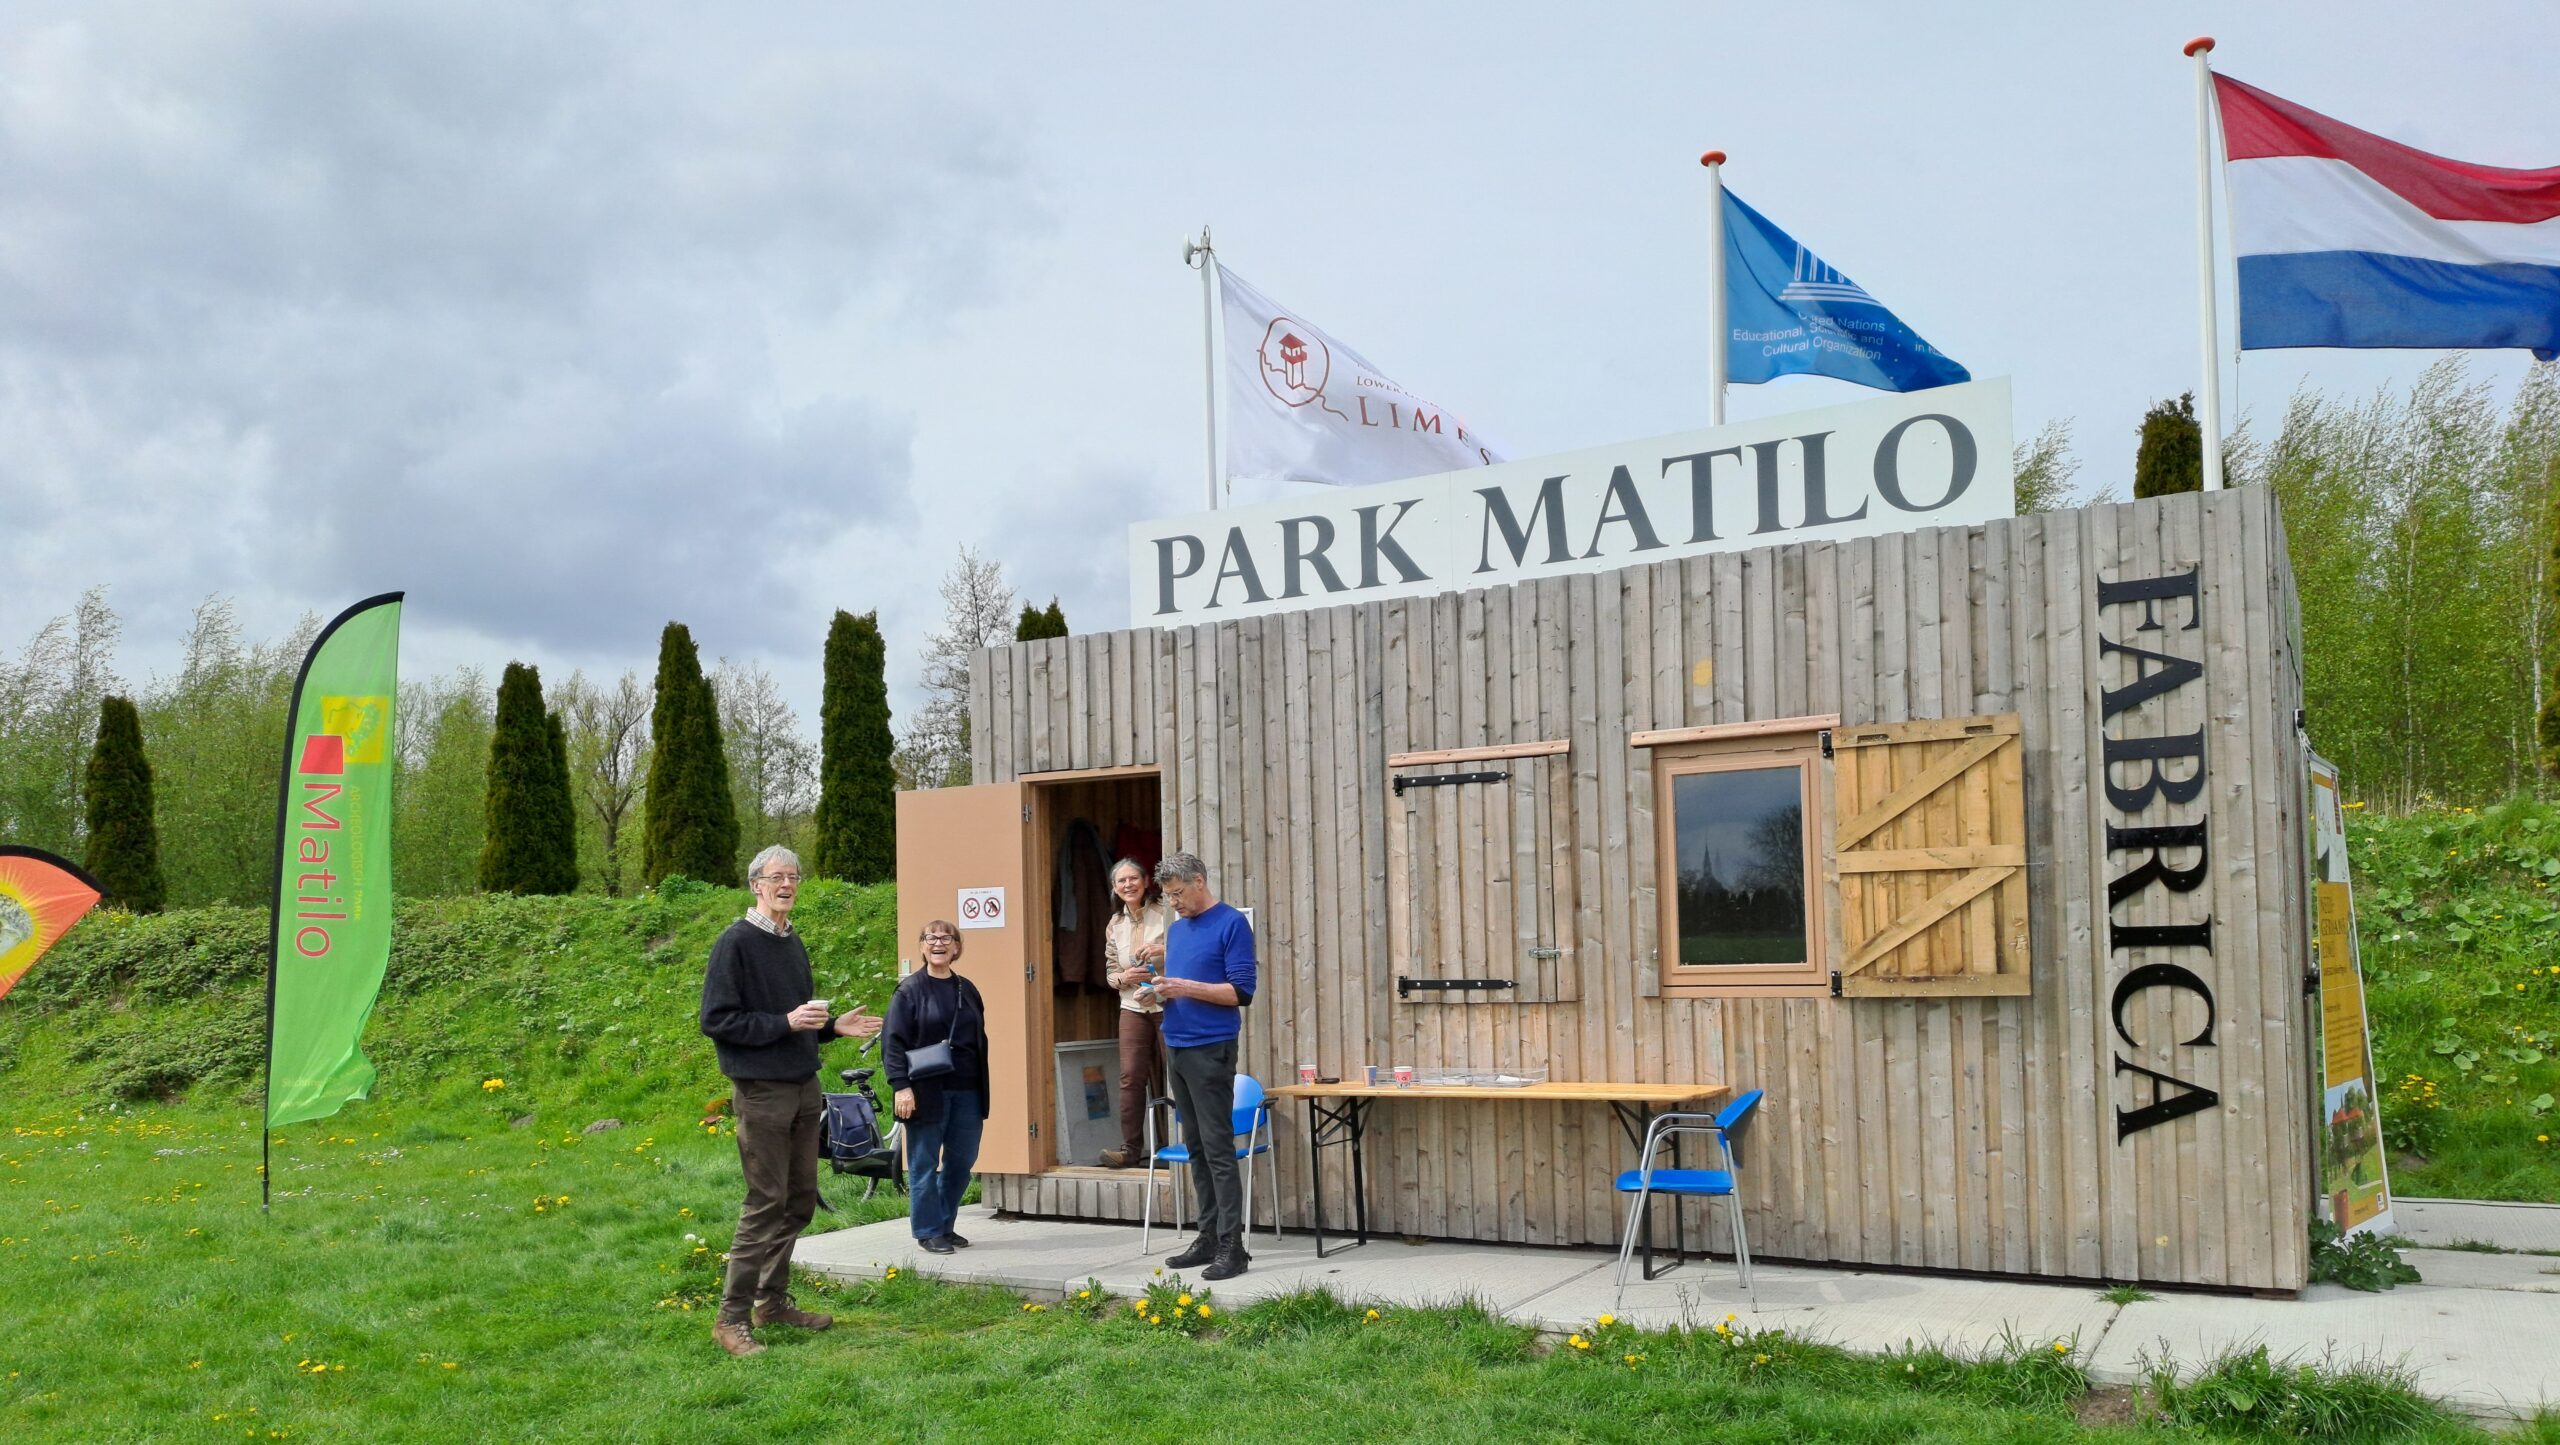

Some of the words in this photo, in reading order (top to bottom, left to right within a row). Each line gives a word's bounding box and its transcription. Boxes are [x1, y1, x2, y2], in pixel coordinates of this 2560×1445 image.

[1762, 339, 1809, 357] Cultural
[1813, 336, 1881, 361] Organization
[1838, 317, 1885, 332] Nations
[1860, 335, 1883, 346] and
[1355, 395, 1492, 466] LIMES
[1151, 497, 1434, 616] PARK
[1472, 412, 1978, 575] MATILO
[295, 782, 347, 958] Matilo
[2097, 562, 2219, 1147] FABRICA
